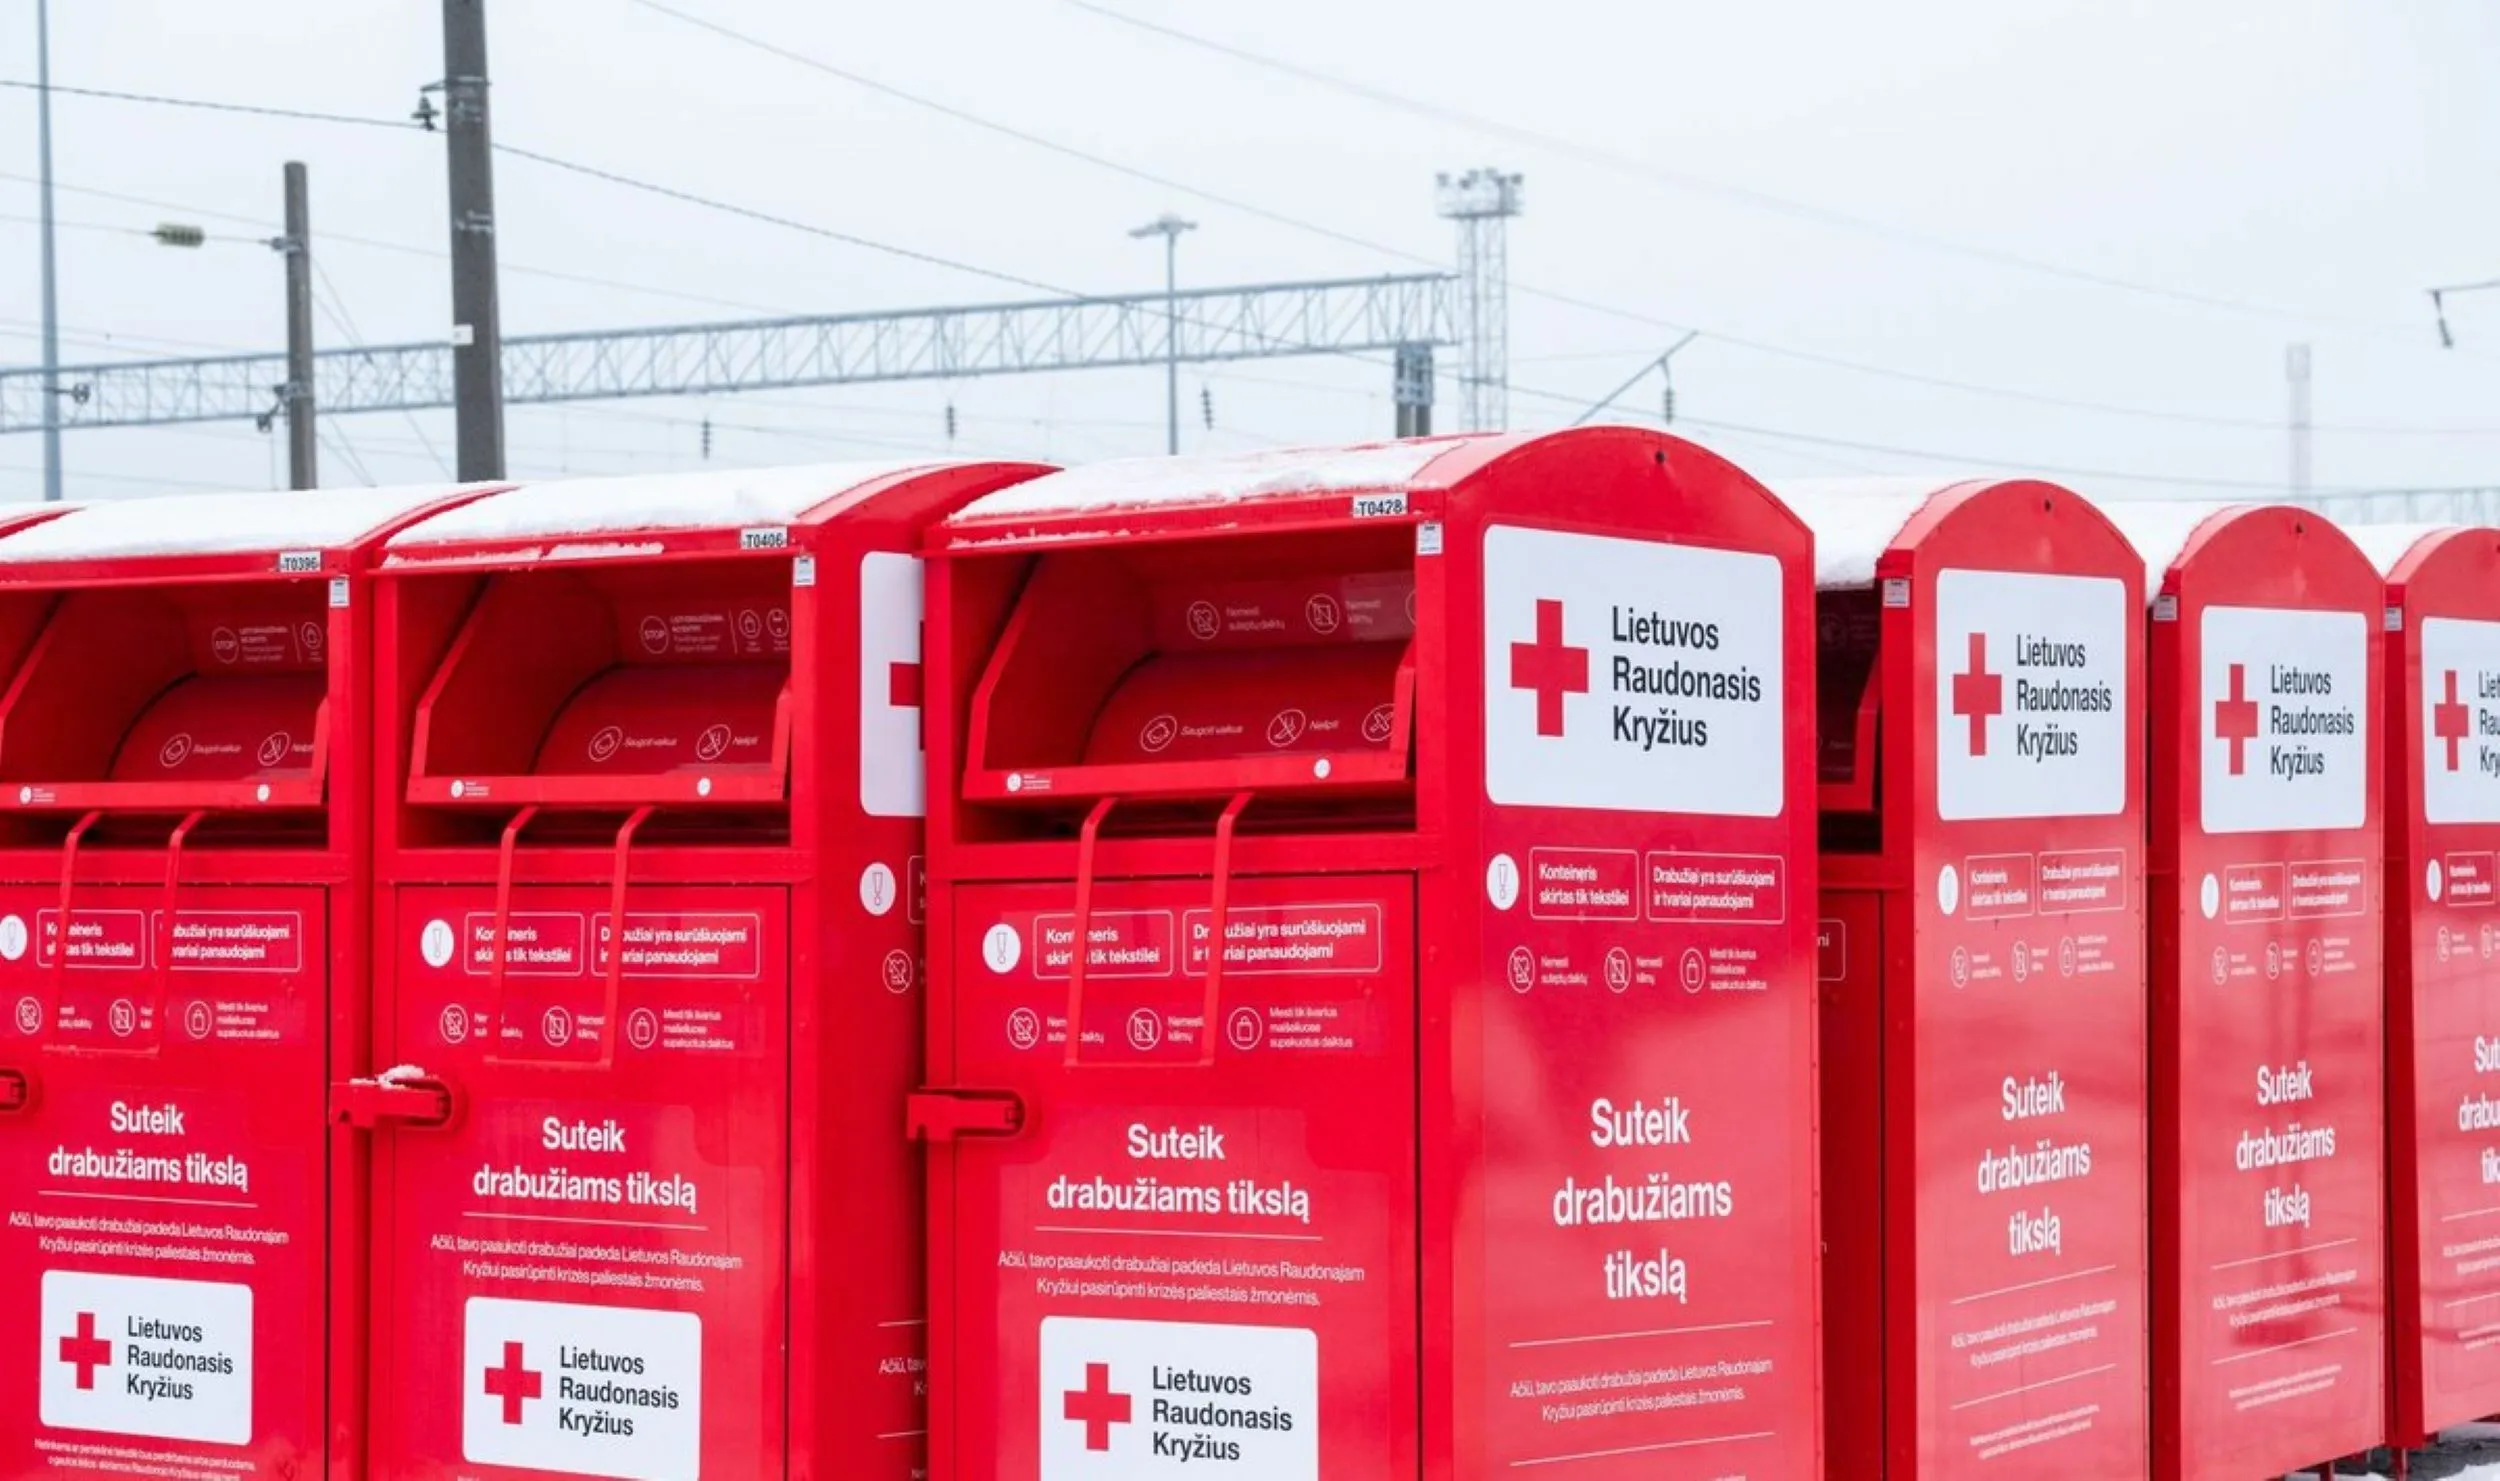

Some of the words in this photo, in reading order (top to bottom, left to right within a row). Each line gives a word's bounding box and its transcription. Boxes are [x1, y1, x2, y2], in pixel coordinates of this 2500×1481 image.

[1357, 499, 1402, 516] T0428
[1612, 605, 1720, 651] Lietuvos
[2016, 634, 2086, 668] Lietuvos
[1612, 655, 1762, 702] Raudonasis
[2016, 679, 2112, 712] Raudonasis
[2271, 664, 2332, 695] Lietuvos
[1612, 704, 1708, 752] Kryžius
[2271, 705, 2354, 735] Raudonasis
[2016, 723, 2078, 763] Kryžius
[2271, 745, 2325, 781] Kryžius
[2002, 1071, 2065, 1121] Suteik
[2257, 1060, 2313, 1106] Suteik
[110, 1101, 186, 1135] Suteik
[541, 1117, 626, 1152] Suteik
[1590, 1096, 1691, 1149] Suteik
[1127, 1123, 1225, 1161] Suteik
[2236, 1124, 2336, 1171] drabužiams
[48, 1145, 182, 1183] drabužiams
[185, 1151, 249, 1193] tikslą
[1977, 1139, 2092, 1194] drabužiams
[472, 1164, 622, 1204] drabužiams
[625, 1170, 697, 1214] tikslą
[1046, 1175, 1221, 1215] drabužiams
[1227, 1180, 1311, 1224] tikslą
[1553, 1172, 1733, 1226] drabužiams
[2264, 1184, 2311, 1229] tikslą
[2008, 1207, 2061, 1257] tikslą
[1604, 1248, 1687, 1304] tikslą
[127, 1315, 203, 1343] Lietuvos
[127, 1344, 234, 1375] Raudonasis
[559, 1345, 645, 1375] Lietuvos
[126, 1372, 194, 1401] Kryžius
[559, 1376, 680, 1409] Raudonasis
[1152, 1365, 1252, 1396] Lietuvos
[558, 1407, 634, 1437] Kryžius
[1152, 1398, 1293, 1431] Raudonasis
[1152, 1431, 1240, 1462] Kryžius
